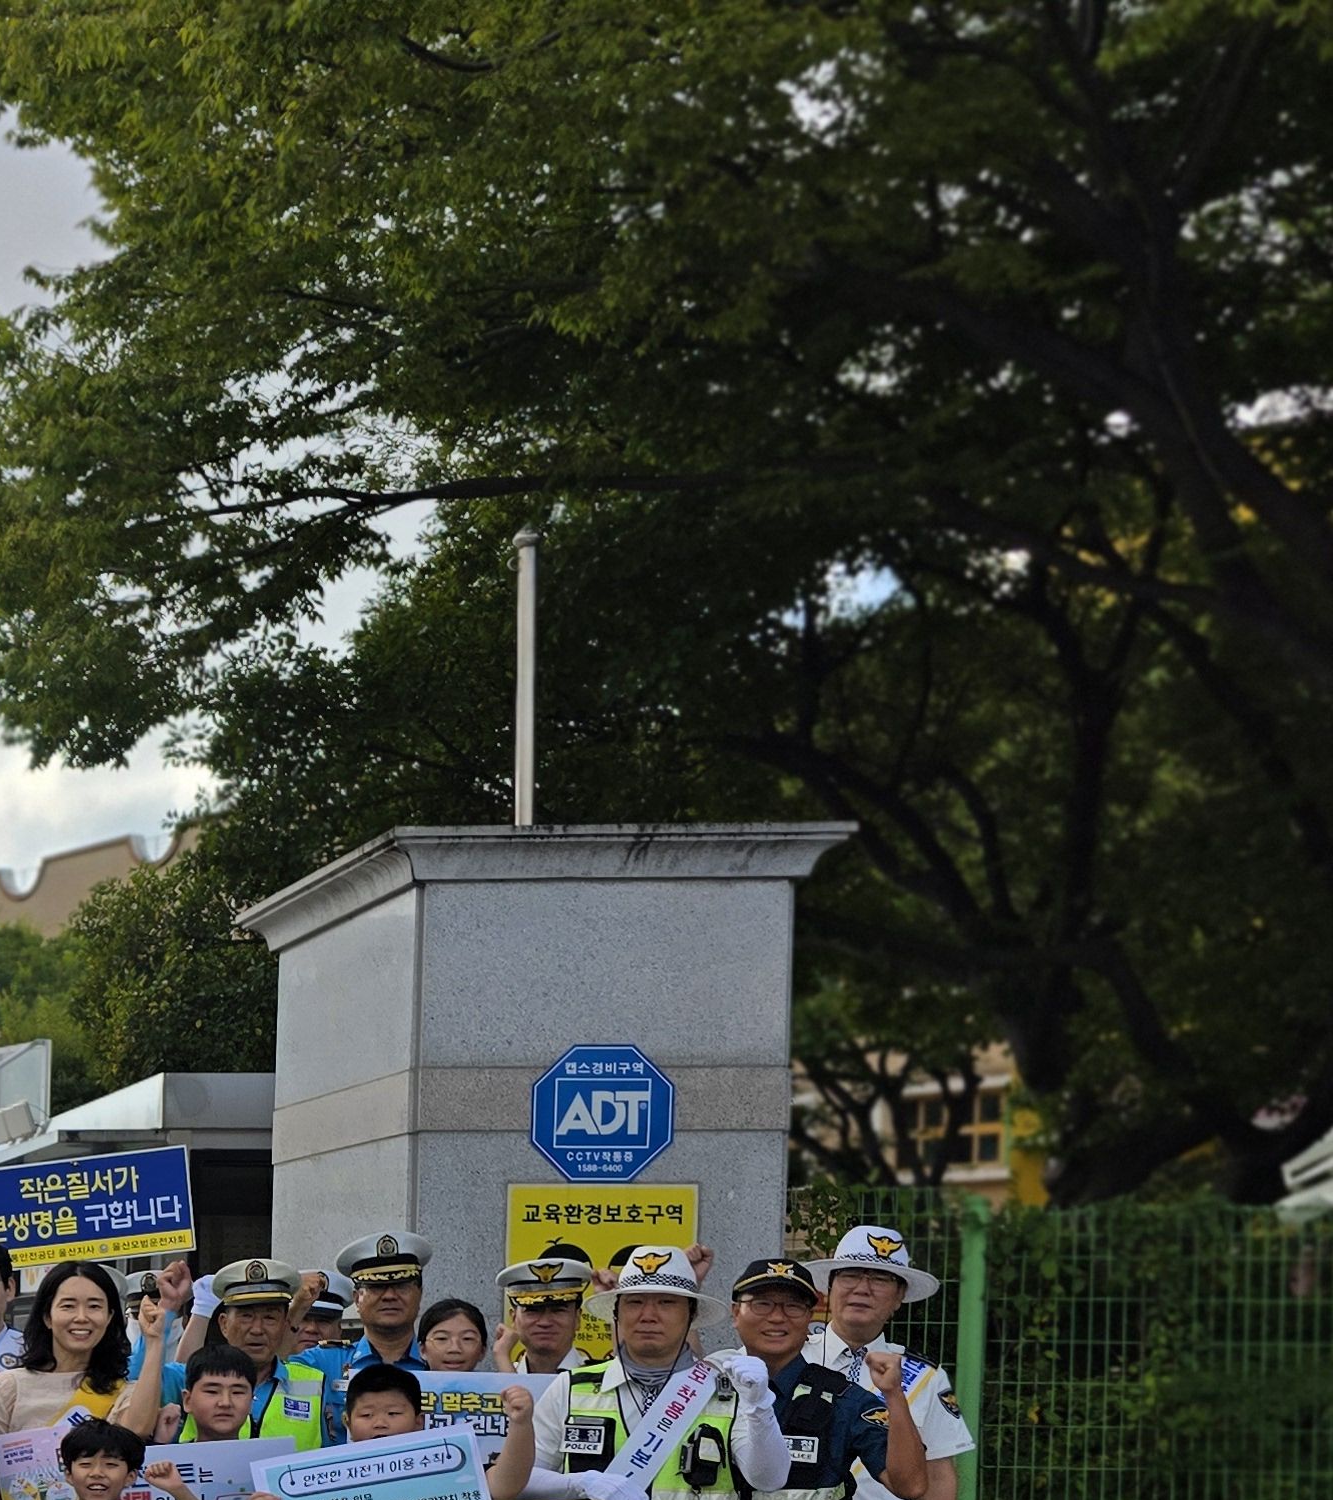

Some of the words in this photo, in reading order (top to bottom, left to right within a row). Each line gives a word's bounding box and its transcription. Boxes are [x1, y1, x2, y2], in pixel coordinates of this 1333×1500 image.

[565, 1062, 644, 1075] 캡스경비구역
[556, 1090, 650, 1136] ADT
[566, 1151, 634, 1162] CCTV작동중
[577, 1164, 623, 1173] 1588-6400
[19, 1165, 139, 1204] 작은질서가
[84, 1195, 183, 1232] 구합니다
[522, 1204, 683, 1225] 교육환경보호구역
[11, 1248, 55, 1263] 통안전공단
[58, 1245, 95, 1259] 울산지사
[112, 1234, 187, 1253] 울산모범운전자회
[441, 1392, 504, 1413] 멈추고
[658, 1385, 697, 1433] 착용은
[465, 1413, 509, 1437] 건너
[566, 1428, 601, 1443] 경찰
[564, 1442, 599, 1452] POLICE
[625, 1431, 663, 1478] 기본!
[346, 1462, 384, 1480] 자전거
[389, 1457, 415, 1473] 이용
